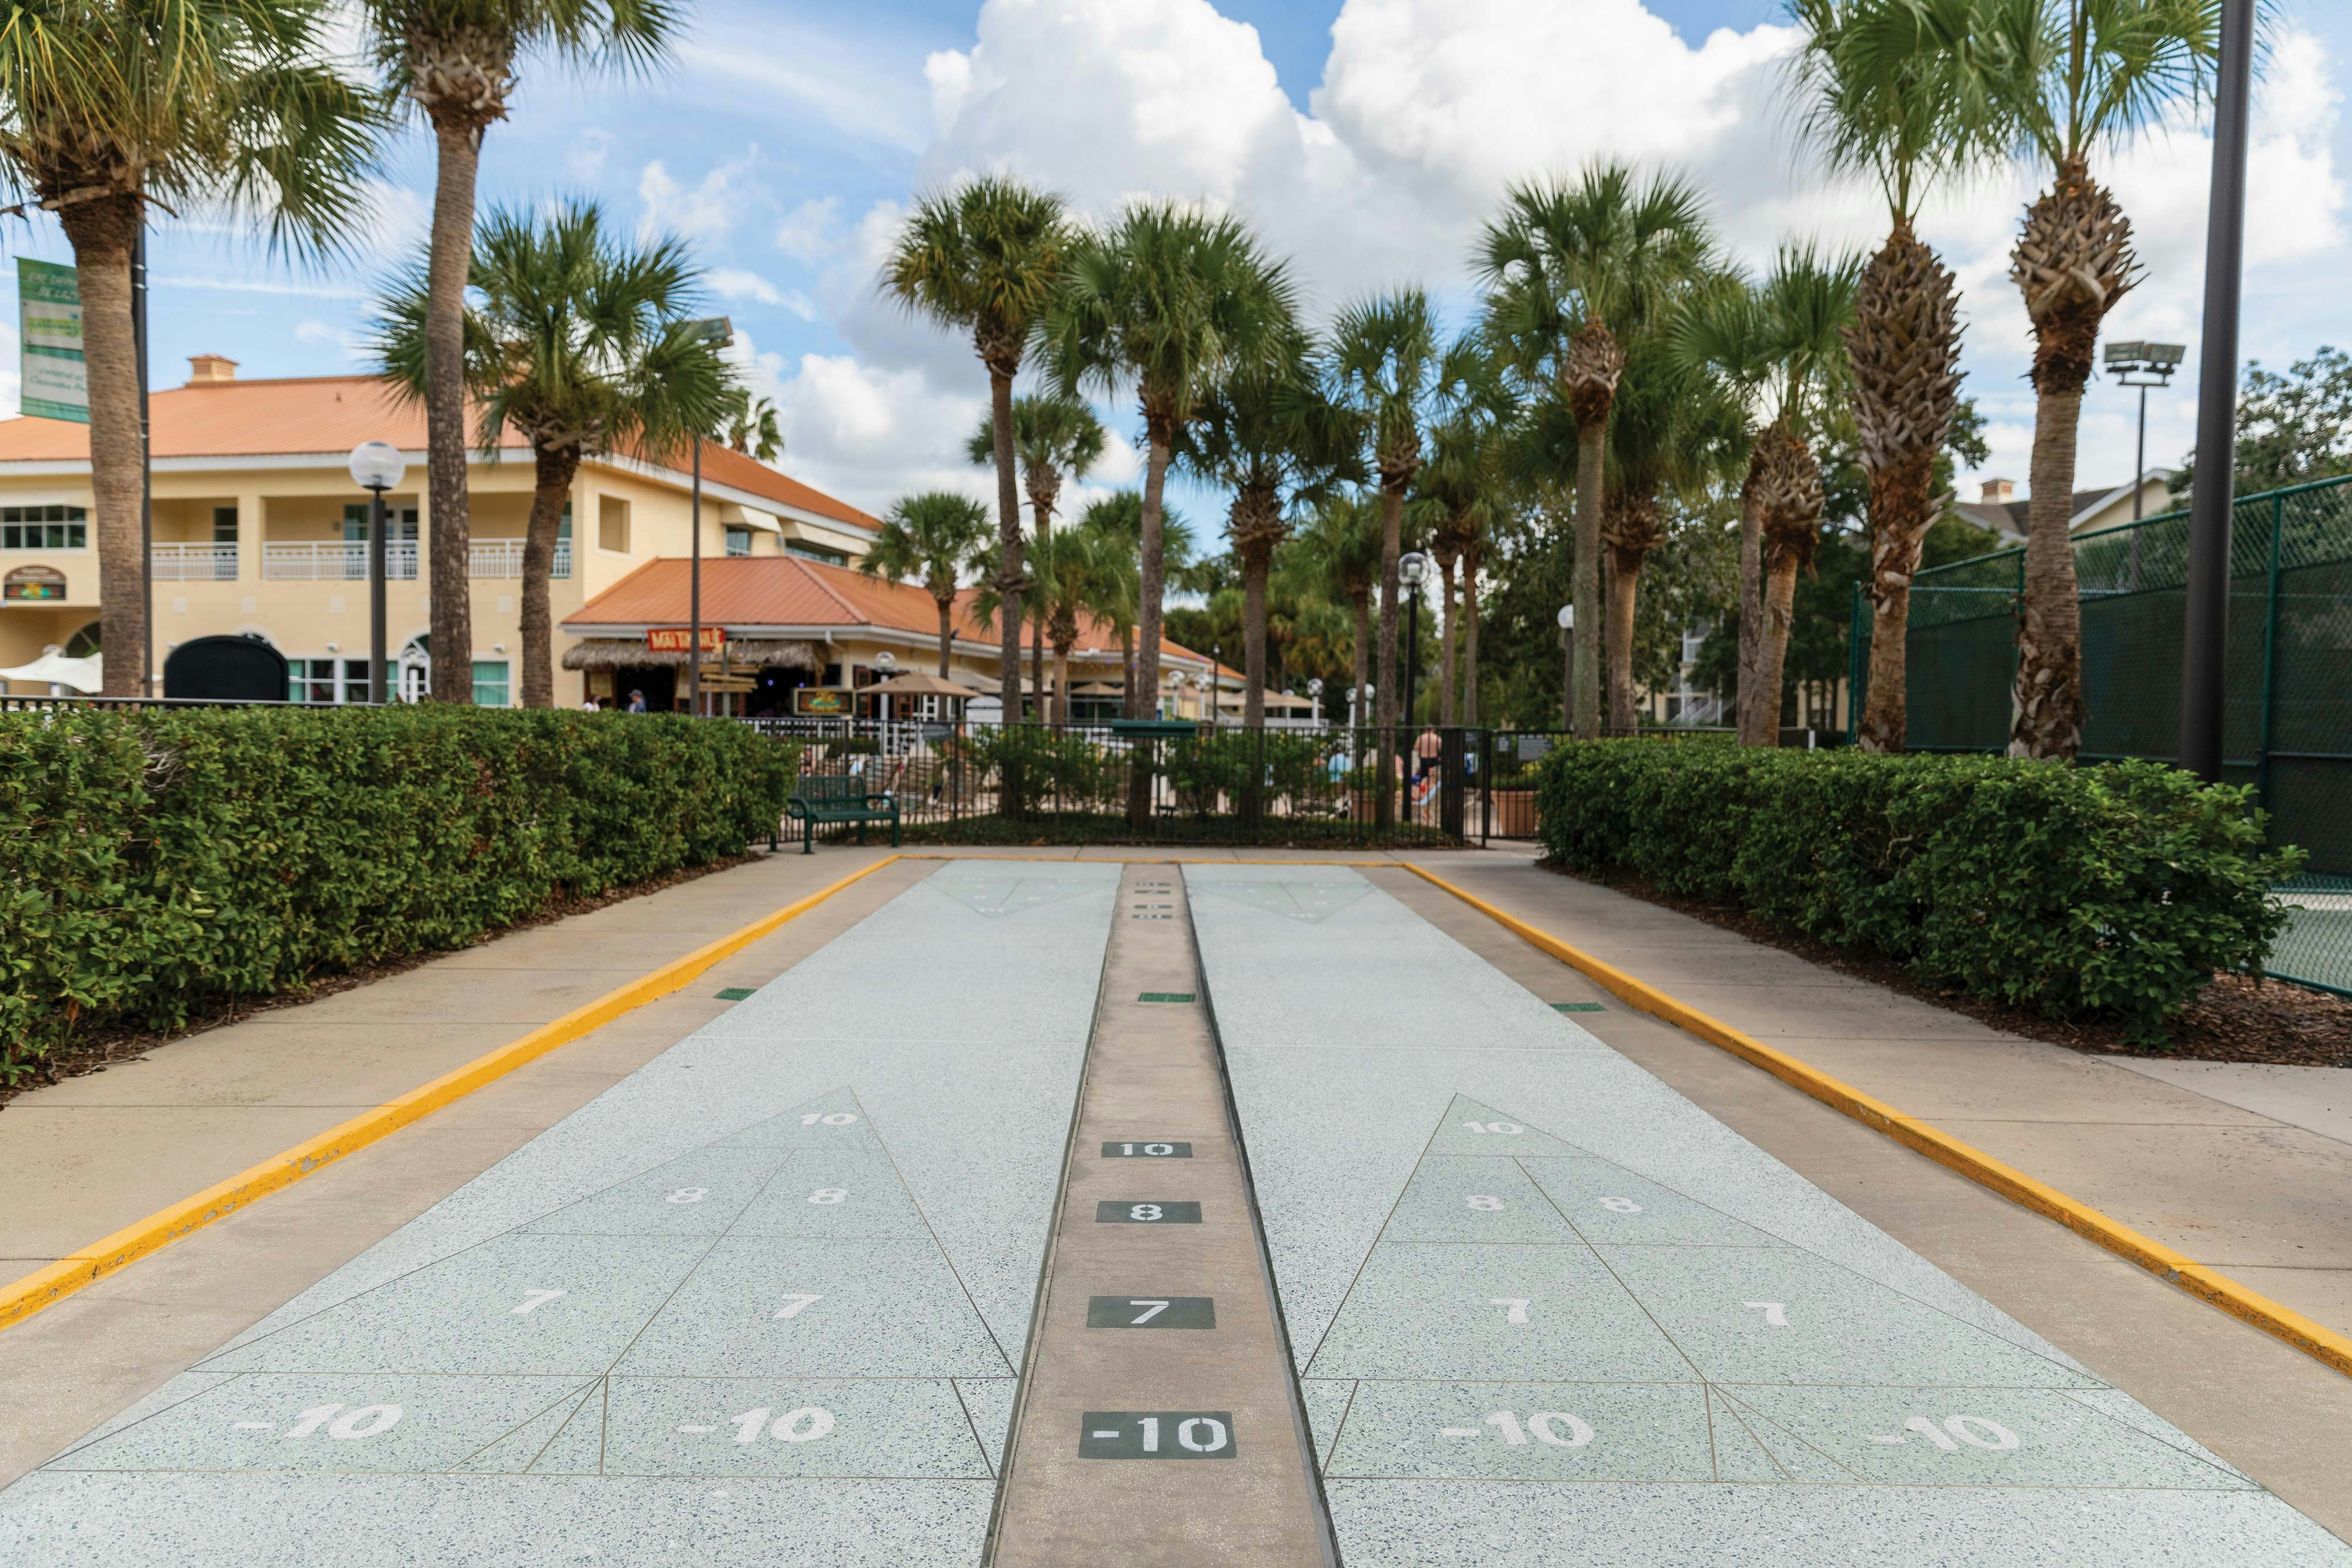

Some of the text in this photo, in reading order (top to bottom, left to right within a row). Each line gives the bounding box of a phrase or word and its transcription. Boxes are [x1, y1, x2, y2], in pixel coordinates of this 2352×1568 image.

[800, 1113, 857, 1125] 10
[1462, 1121, 1525, 1135] 10
[1121, 1143, 1173, 1156] 10
[665, 1187, 709, 1203] 8
[807, 1188, 848, 1204] 8
[1465, 1194, 1505, 1212] 8
[1131, 1204, 1163, 1221] 8
[1599, 1196, 1643, 1213] 8
[510, 1289, 567, 1313] 7
[773, 1293, 823, 1318] 7
[1130, 1300, 1170, 1324] 7
[1489, 1298, 1530, 1323] 7
[1743, 1301, 1791, 1328] 7
[1093, 1417, 1227, 1452] -10
